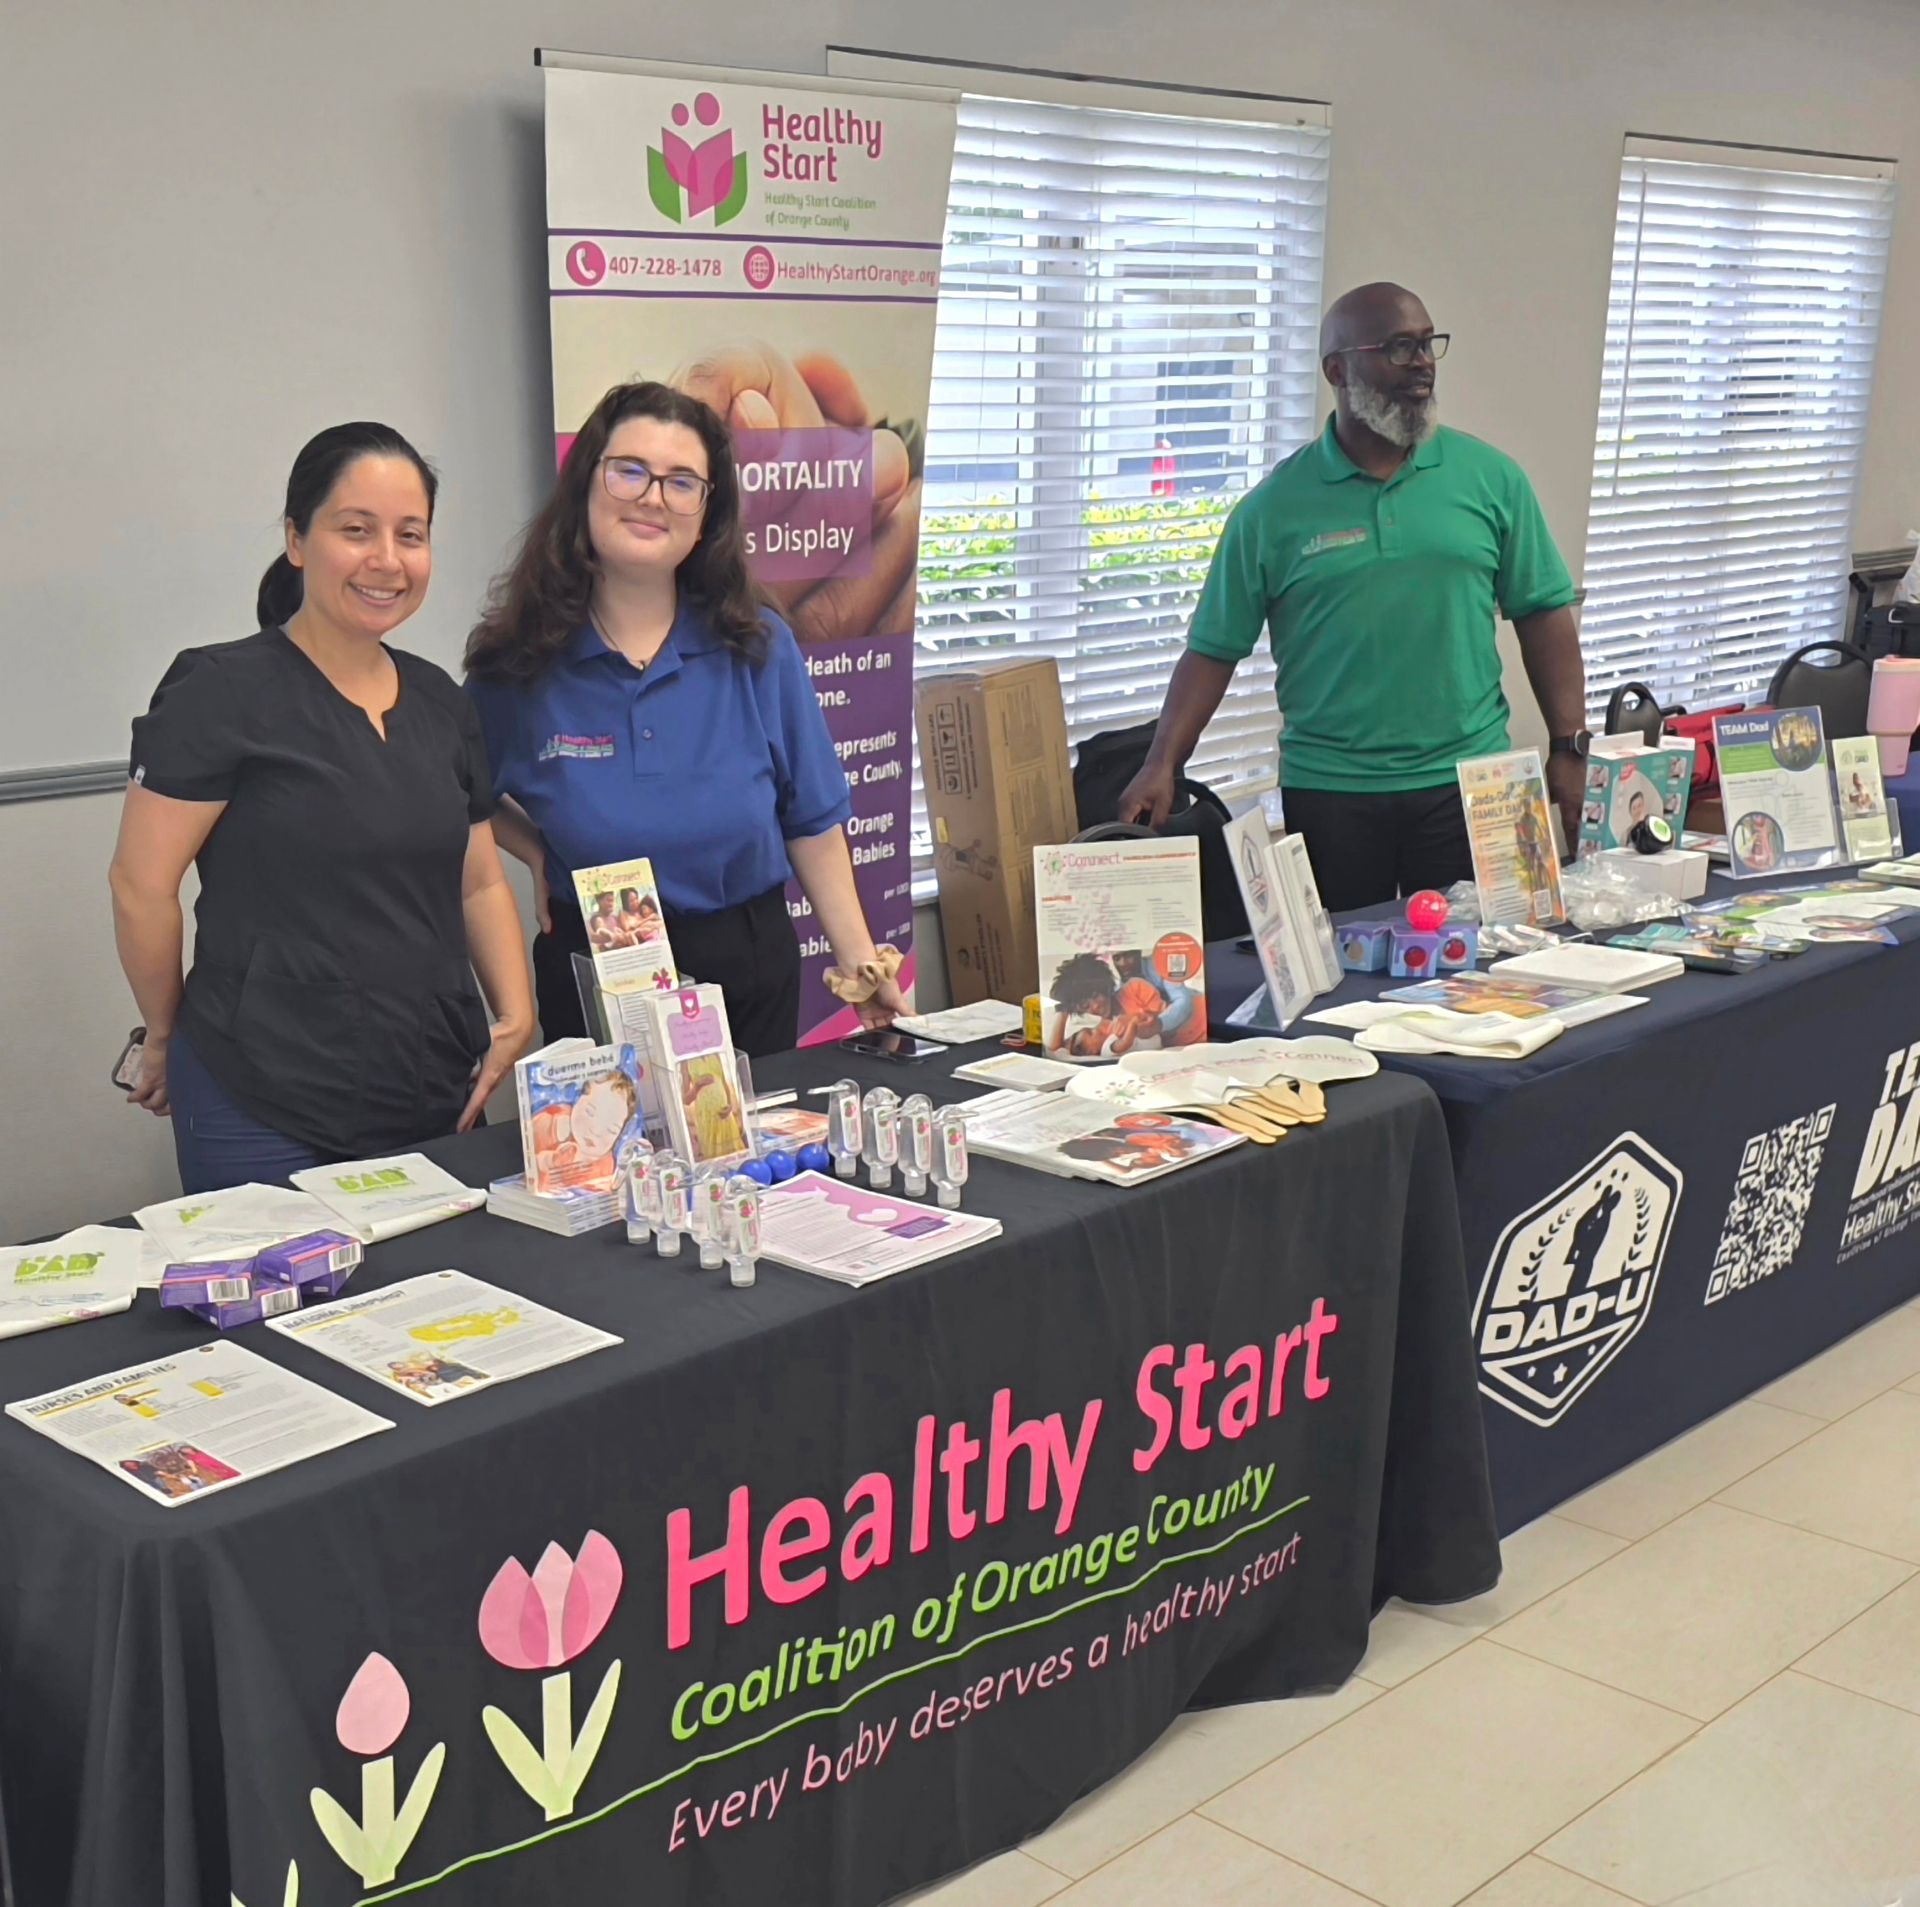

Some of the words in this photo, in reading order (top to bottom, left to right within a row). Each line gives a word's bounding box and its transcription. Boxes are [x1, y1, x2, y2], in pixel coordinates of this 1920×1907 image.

[762, 103, 882, 159] Healthy
[764, 144, 838, 182] Start
[764, 192, 803, 210] Healthy
[805, 194, 829, 208] Start
[831, 195, 877, 210] Coalition
[765, 211, 775, 226] of
[777, 212, 812, 228] Orange
[814, 214, 850, 231] County
[609, 256, 722, 277] 407-228-1478
[777, 261, 936, 287] HealthyStartOrange.org
[735, 459, 863, 492] ORTALITY
[766, 519, 854, 558] Display
[857, 649, 873, 672] of
[875, 652, 891, 669] an
[1720, 722, 1749, 736] TEAM
[1749, 721, 1769, 733] Dad
[834, 730, 897, 761] epresents
[847, 812, 894, 836] Orange
[852, 841, 896, 866] Babies
[1067, 852, 1121, 868] Connect
[1840, 1193, 1903, 1248] Healthy
[1480, 1271, 1651, 1354] DAD-U
[25, 1391, 84, 1414] NURSES
[84, 1381, 114, 1397] AND
[667, 1387, 1103, 1650] Healthy
[1133, 1297, 1337, 1472] Start
[671, 1615, 896, 1742] Coalition
[912, 1585, 965, 1644] of
[972, 1530, 1140, 1613] Orange
[1147, 1462, 1276, 1546] County
[668, 1769, 788, 1853] Every
[802, 1717, 899, 1793] baby
[908, 1647, 1075, 1741] deserves
[1087, 1636, 1109, 1669] a
[1122, 1576, 1233, 1659] healthy
[1239, 1532, 1303, 1602] start
